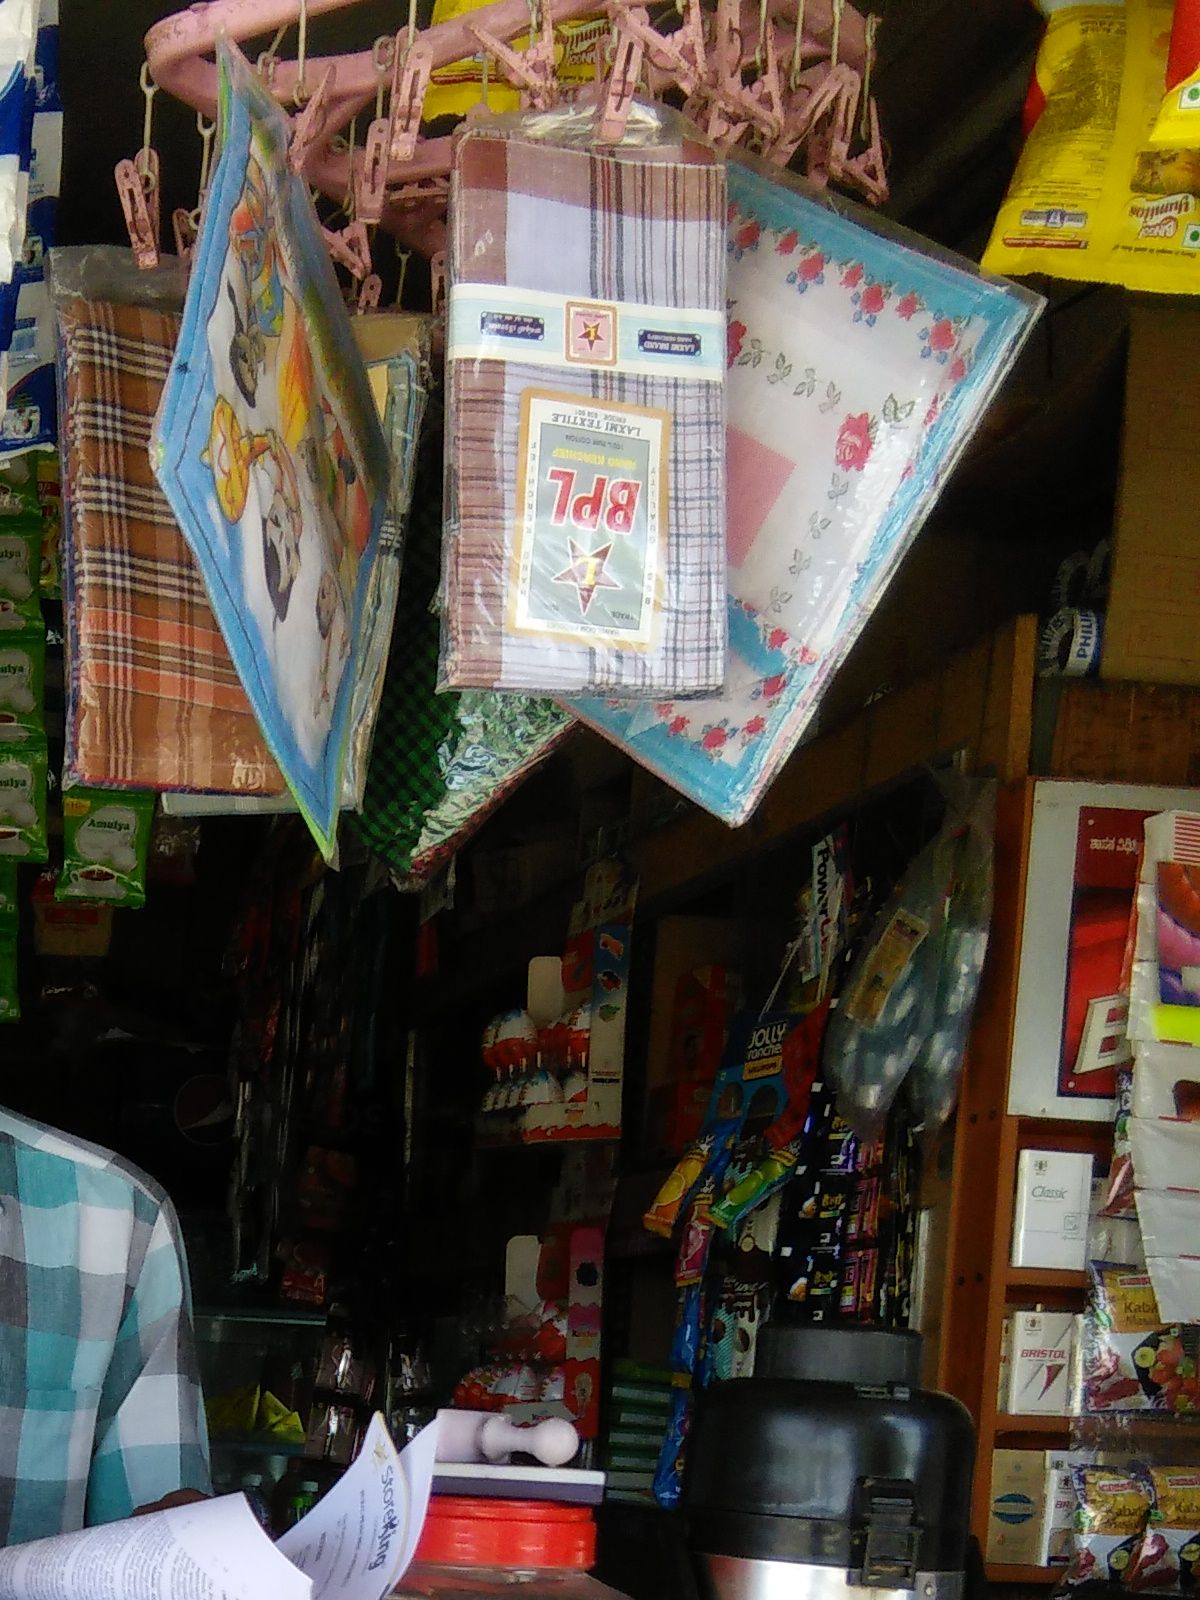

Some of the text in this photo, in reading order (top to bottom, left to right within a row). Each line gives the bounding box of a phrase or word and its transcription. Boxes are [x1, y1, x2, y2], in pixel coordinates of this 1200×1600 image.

[552, 412, 641, 437] LAXMI TEXTILE
[548, 467, 642, 535] BPL
[87, 817, 130, 831] Amulya
[746, 1024, 786, 1048] JOLLY
[1020, 1348, 1068, 1360] BRISTOL
